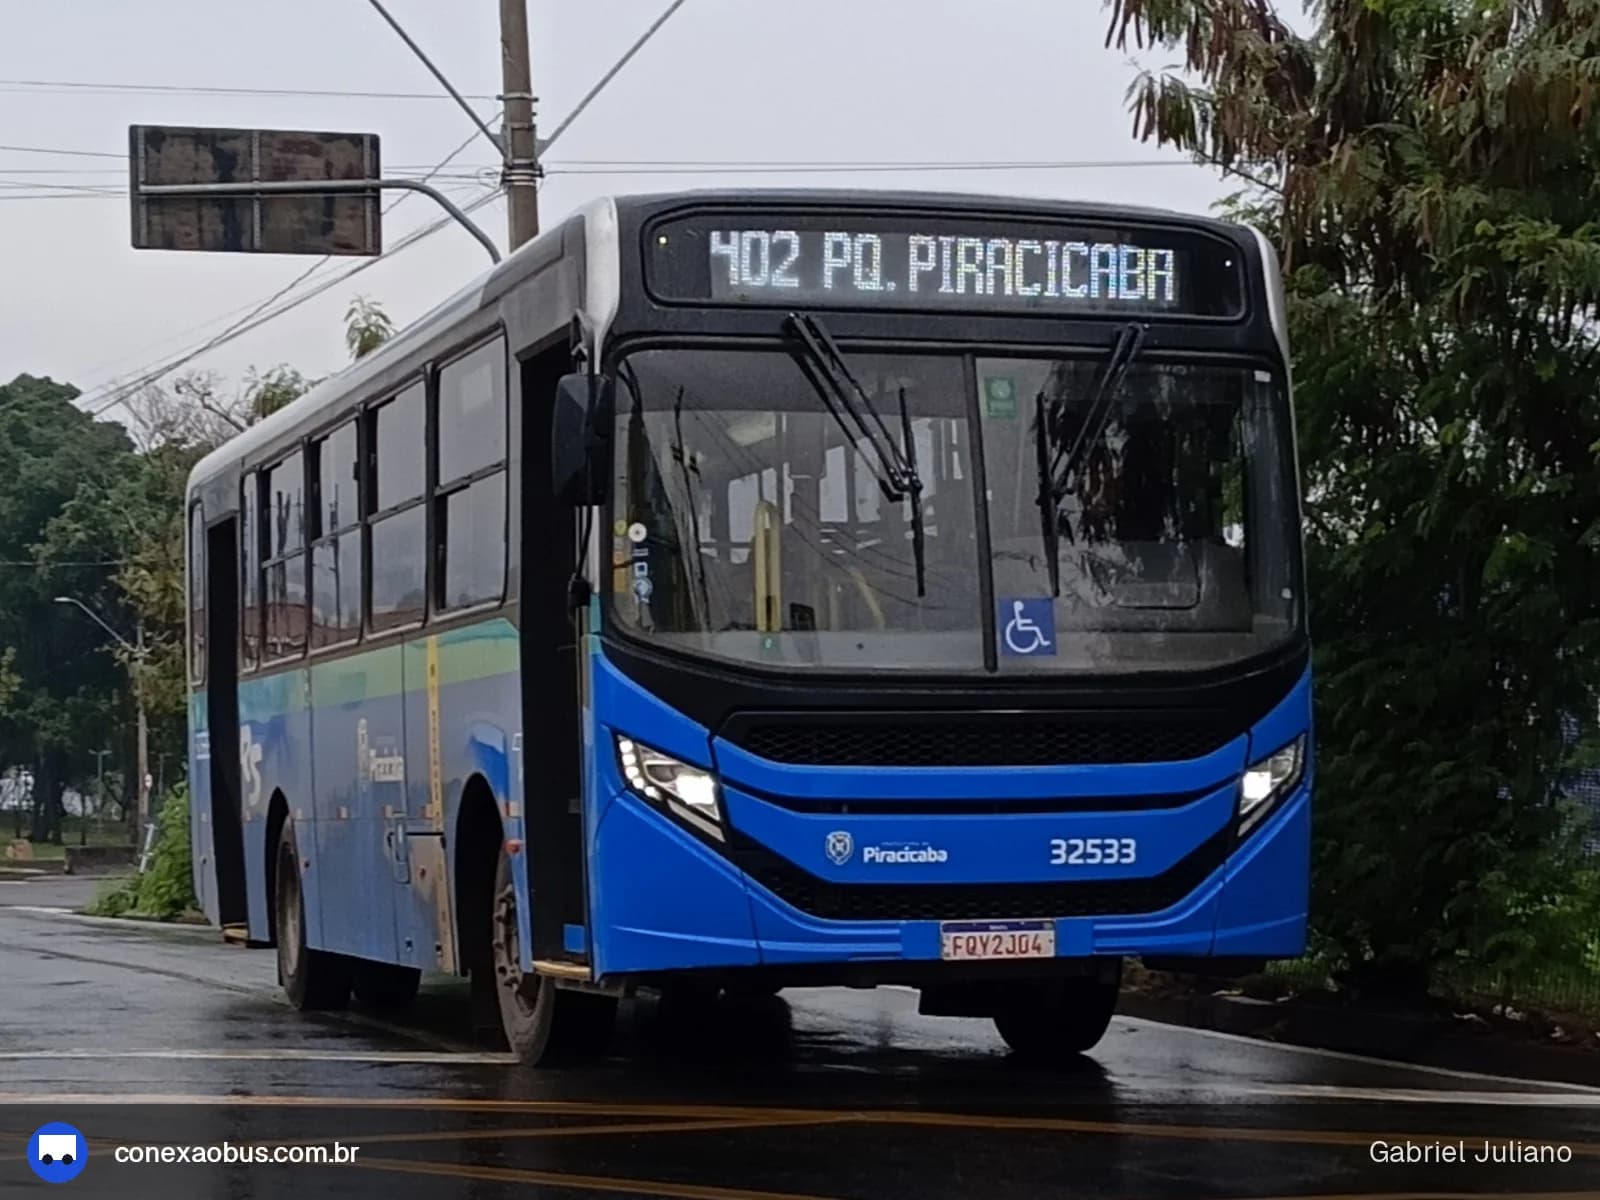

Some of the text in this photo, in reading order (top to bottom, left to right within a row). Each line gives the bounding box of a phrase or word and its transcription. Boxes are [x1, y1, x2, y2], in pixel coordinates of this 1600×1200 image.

[710, 230, 1174, 300] 402 PQ. PIRACICABA
[863, 846, 948, 863] Piracicaba
[1049, 838, 1137, 865] 32533
[952, 934, 1042, 956] FQY2J04
